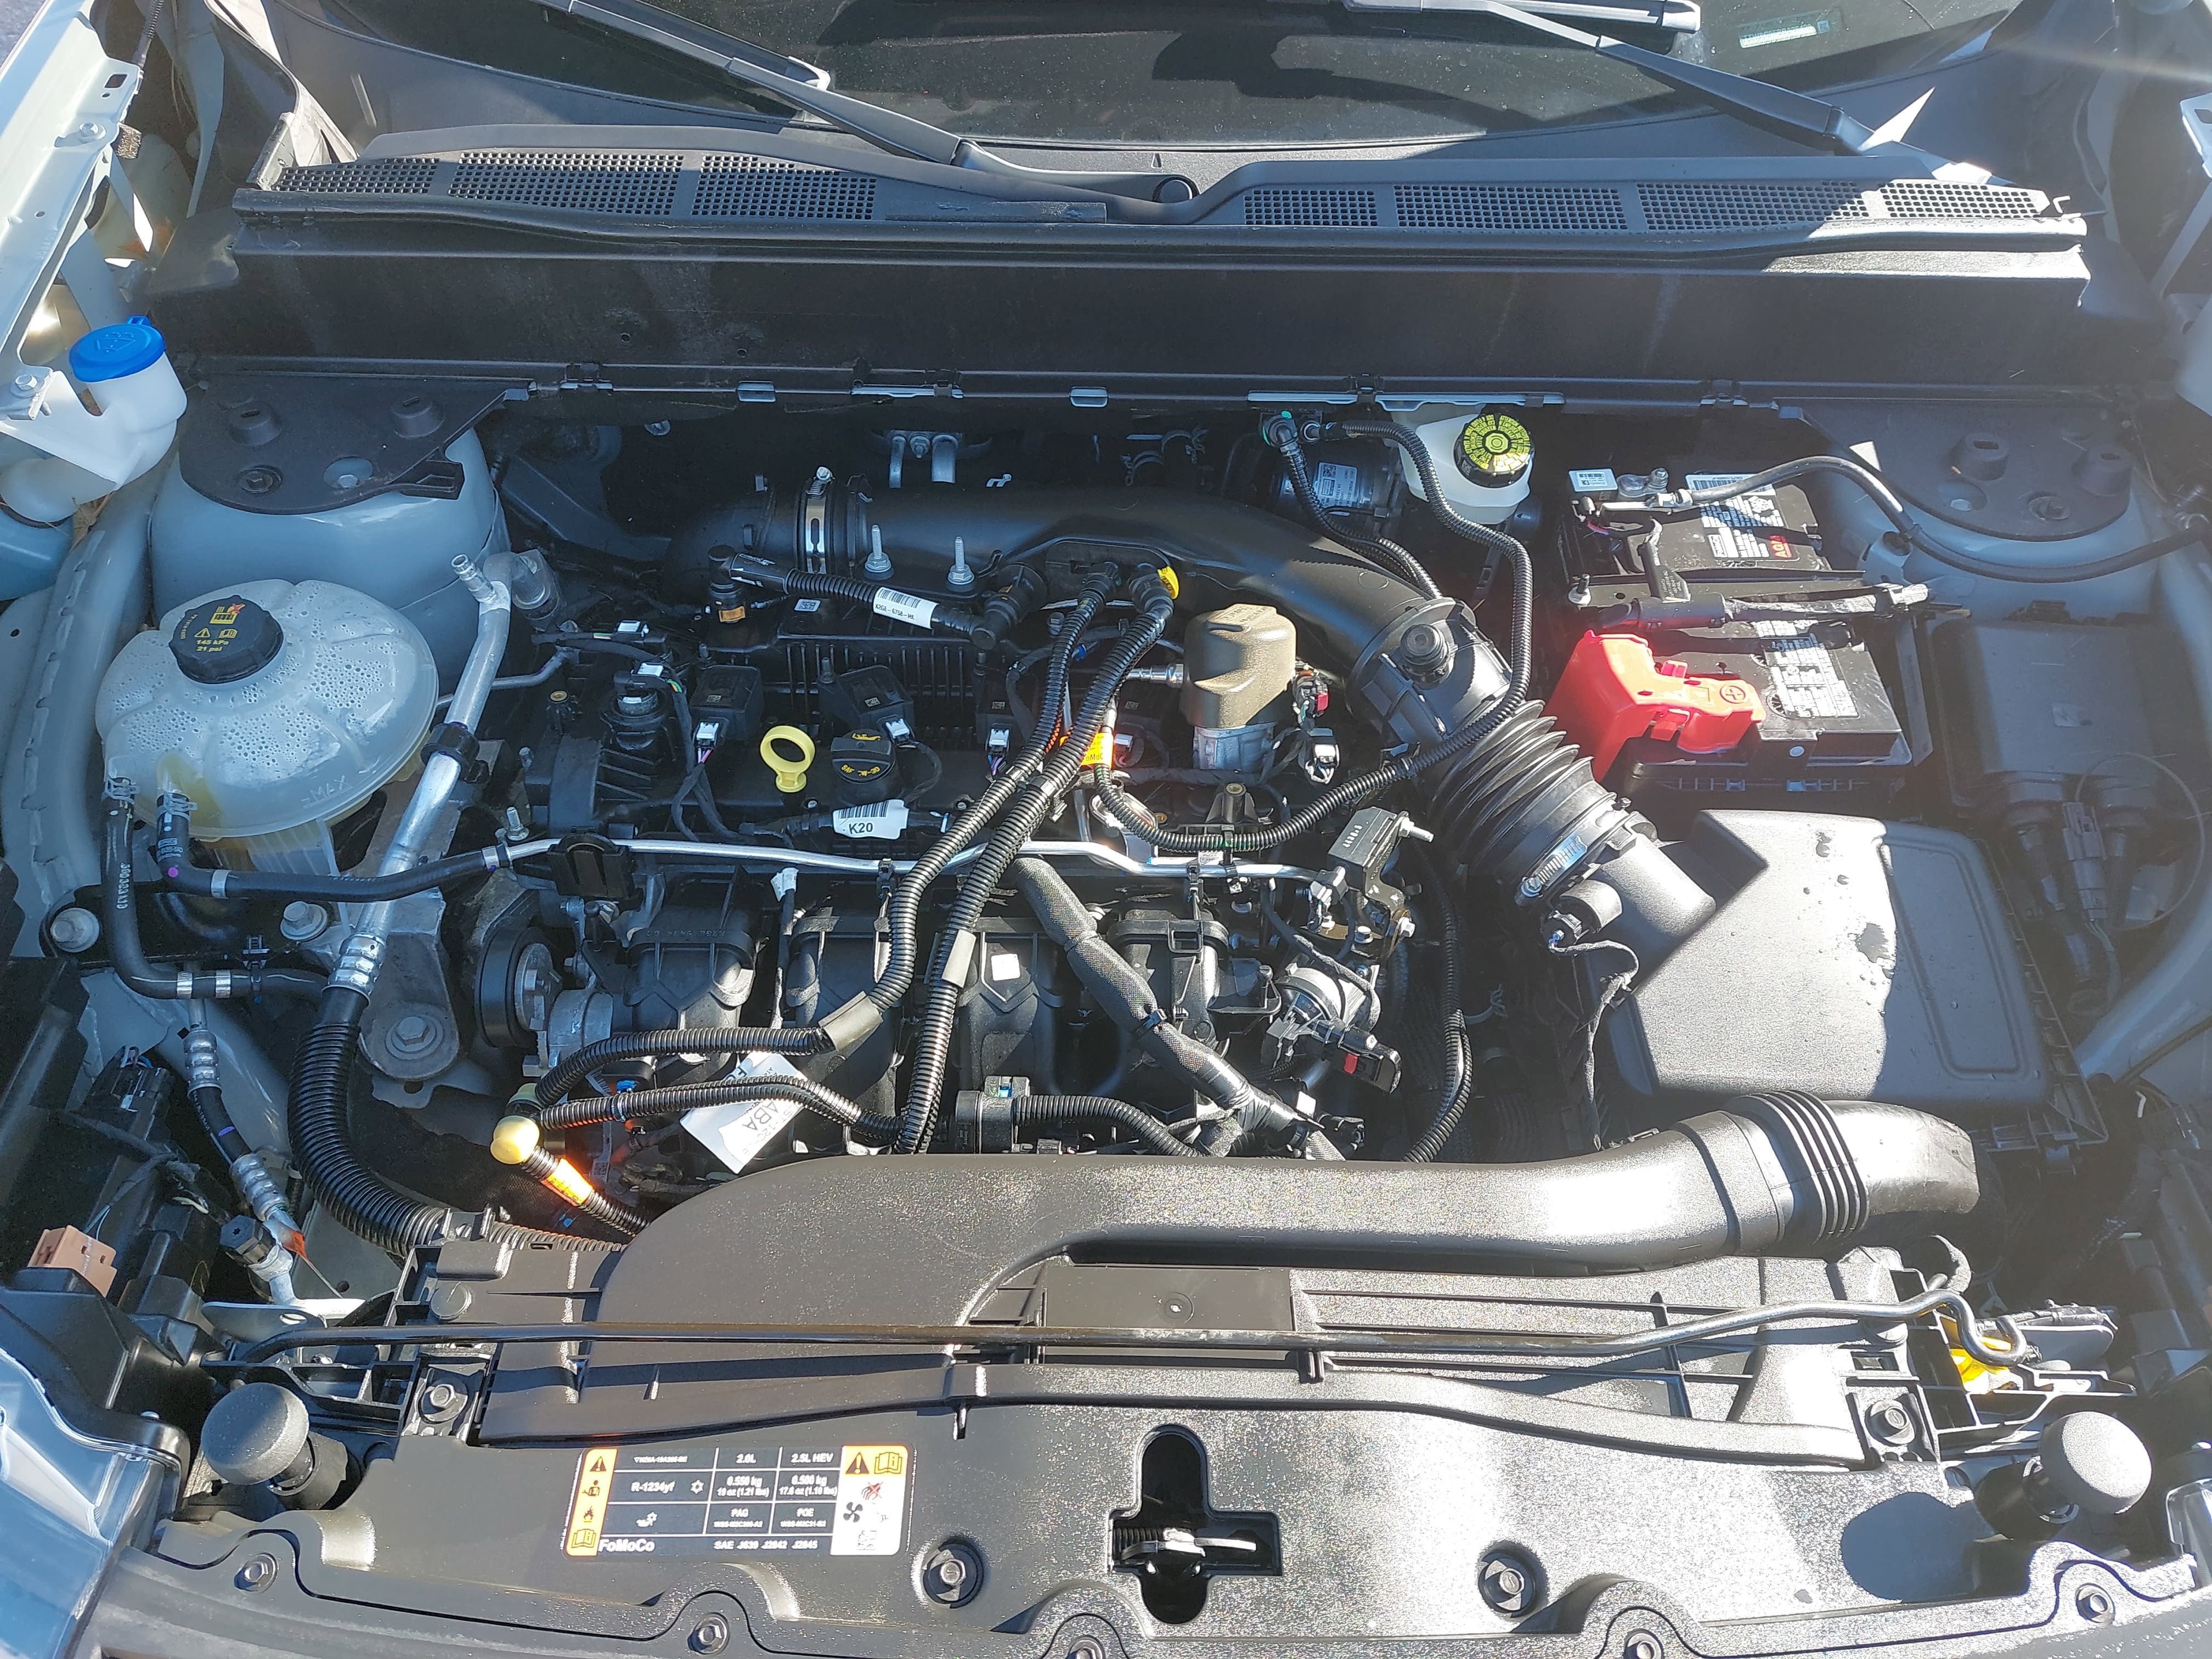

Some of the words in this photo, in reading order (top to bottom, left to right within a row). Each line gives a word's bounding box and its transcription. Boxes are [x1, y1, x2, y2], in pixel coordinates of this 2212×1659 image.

[849, 822, 873, 834] K20
[742, 1101, 778, 1131] ABA
[736, 1453, 757, 1464] 2.0L
[791, 1453, 811, 1464] 2.5L
[812, 1453, 833, 1463] HEV
[751, 1475, 763, 1488] kg
[816, 1475, 828, 1487] kg
[631, 1481, 676, 1494] R-1234yf
[731, 1509, 749, 1517] PAG
[797, 1508, 815, 1517] POE
[598, 1538, 655, 1552] FoMoCo
[714, 1541, 735, 1549] SAE
